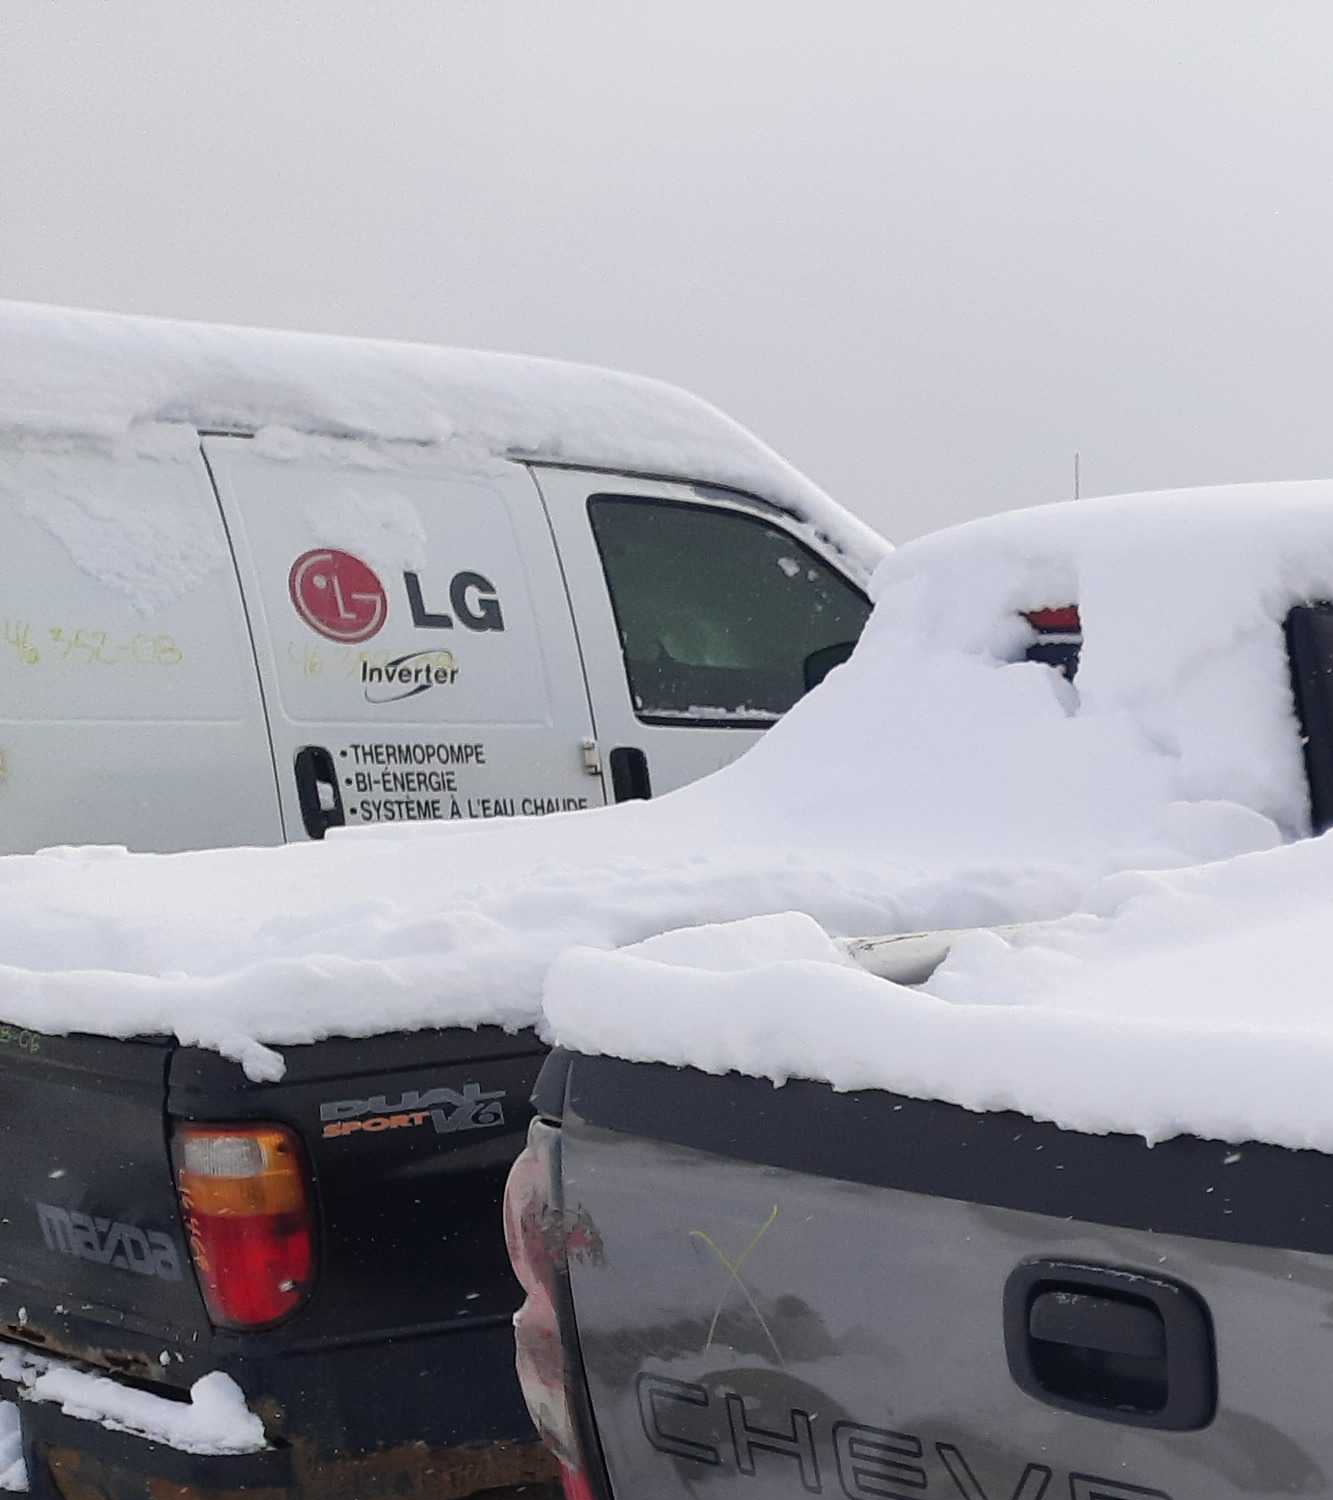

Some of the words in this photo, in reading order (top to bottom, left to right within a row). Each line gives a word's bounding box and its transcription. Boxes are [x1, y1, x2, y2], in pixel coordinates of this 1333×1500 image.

[403, 571, 505, 632] LG
[361, 660, 460, 684] Inverter
[350, 743, 486, 765] THERMOPOMPE
[355, 767, 458, 793] BI-ÉNERGIE
[360, 794, 441, 821] SYSTÈME
[468, 798, 515, 818] L'EAU
[320, 1082, 507, 1121] DUAL
[323, 1111, 431, 1139] SPORT
[431, 1101, 505, 1135] V6
